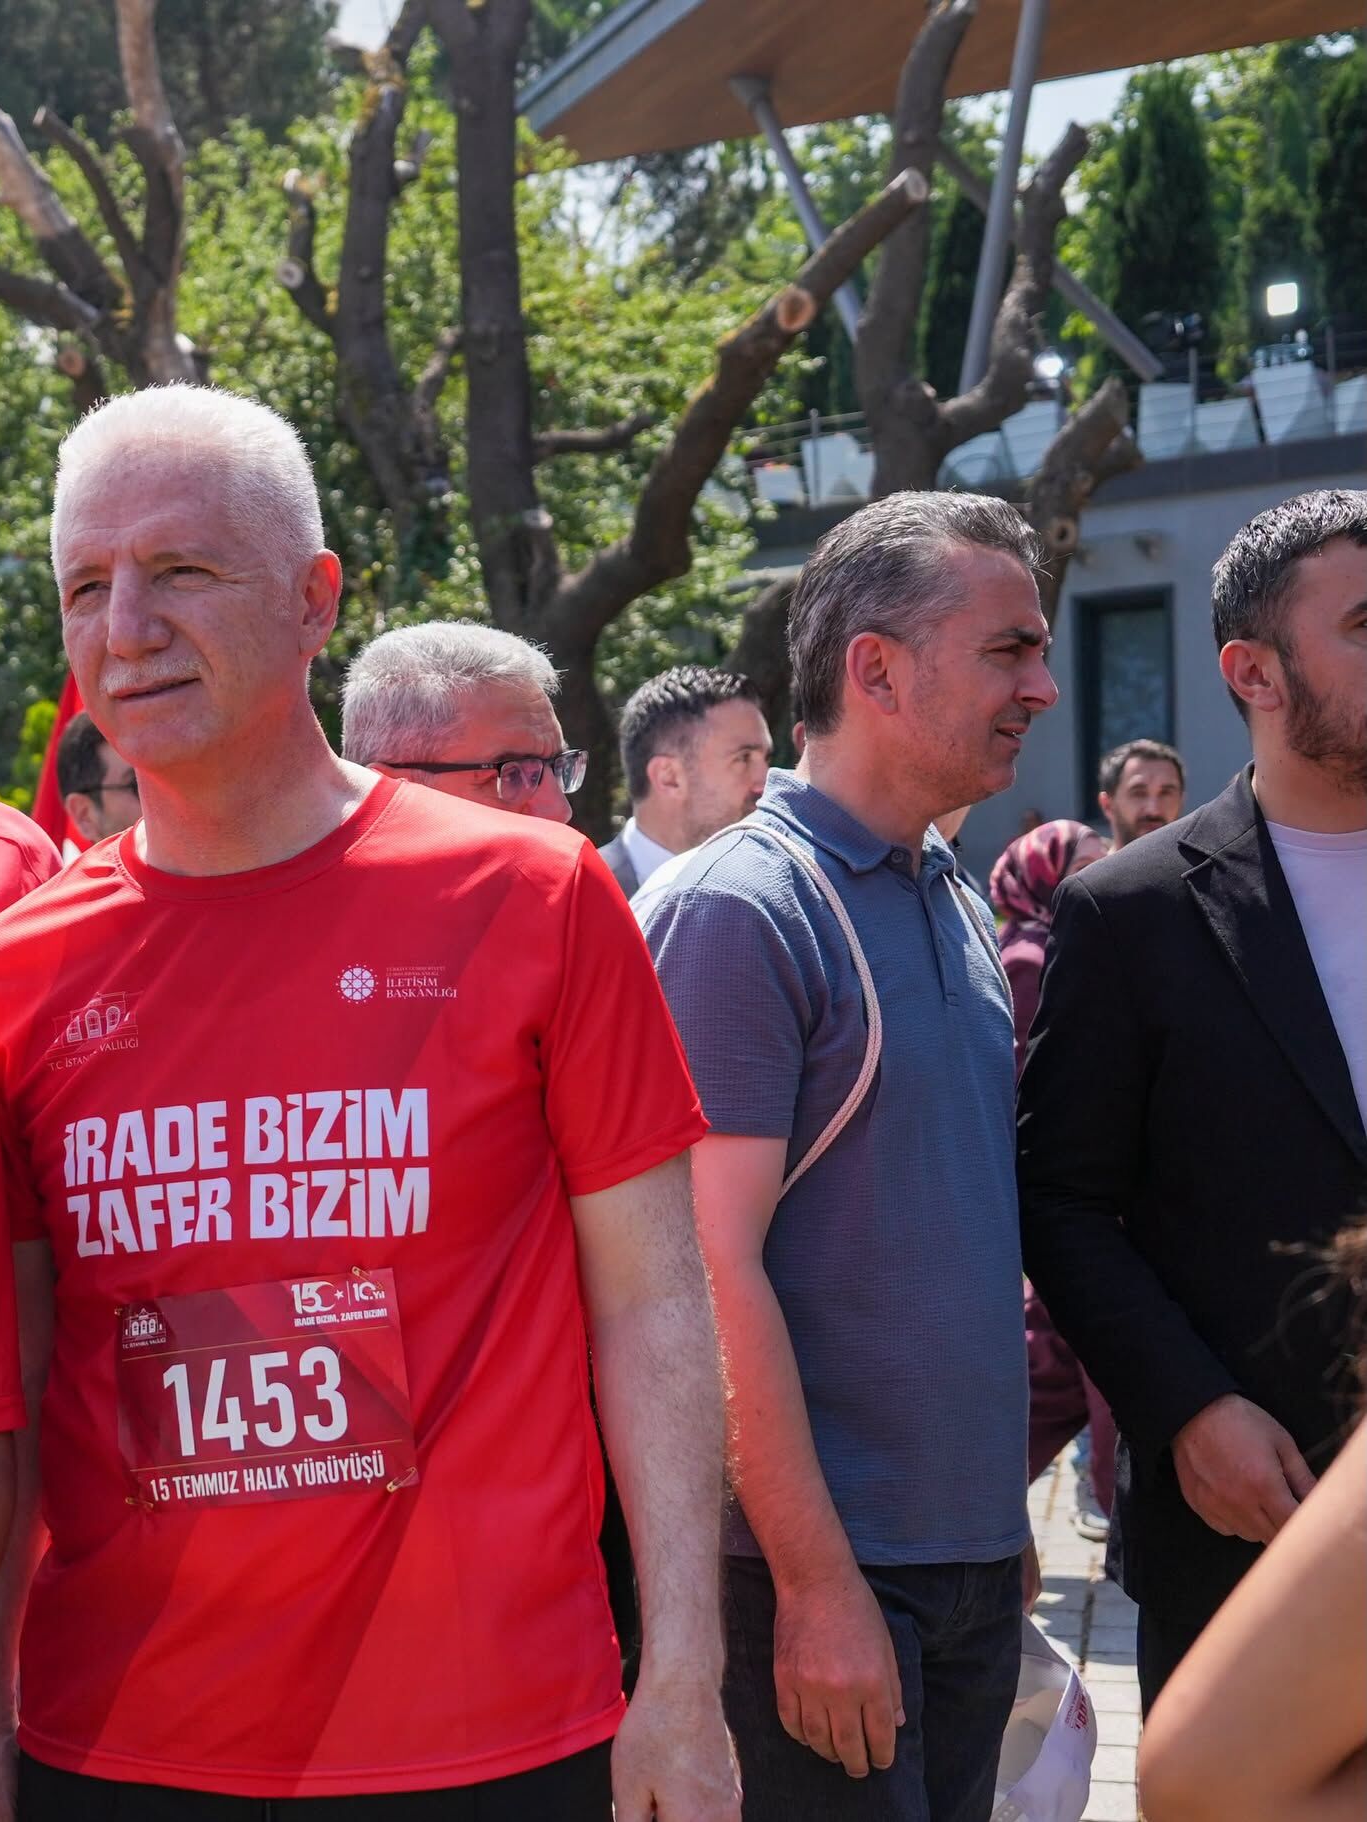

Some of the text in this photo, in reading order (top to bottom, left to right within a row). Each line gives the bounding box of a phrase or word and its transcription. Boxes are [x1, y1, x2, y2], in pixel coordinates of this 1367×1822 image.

[386, 976, 438, 989] İLETİŞİM
[386, 987, 458, 999] BAŞKANLIĞI
[64, 1088, 428, 1188] İRADE BİZİM
[67, 1166, 430, 1258] ZAFER BİZİM
[340, 1311, 363, 1322] ZAFER
[163, 1346, 349, 1457] 1453
[150, 1450, 385, 1501] 15 TEMMUZ HALK YÜRÜYÜŞÜ
